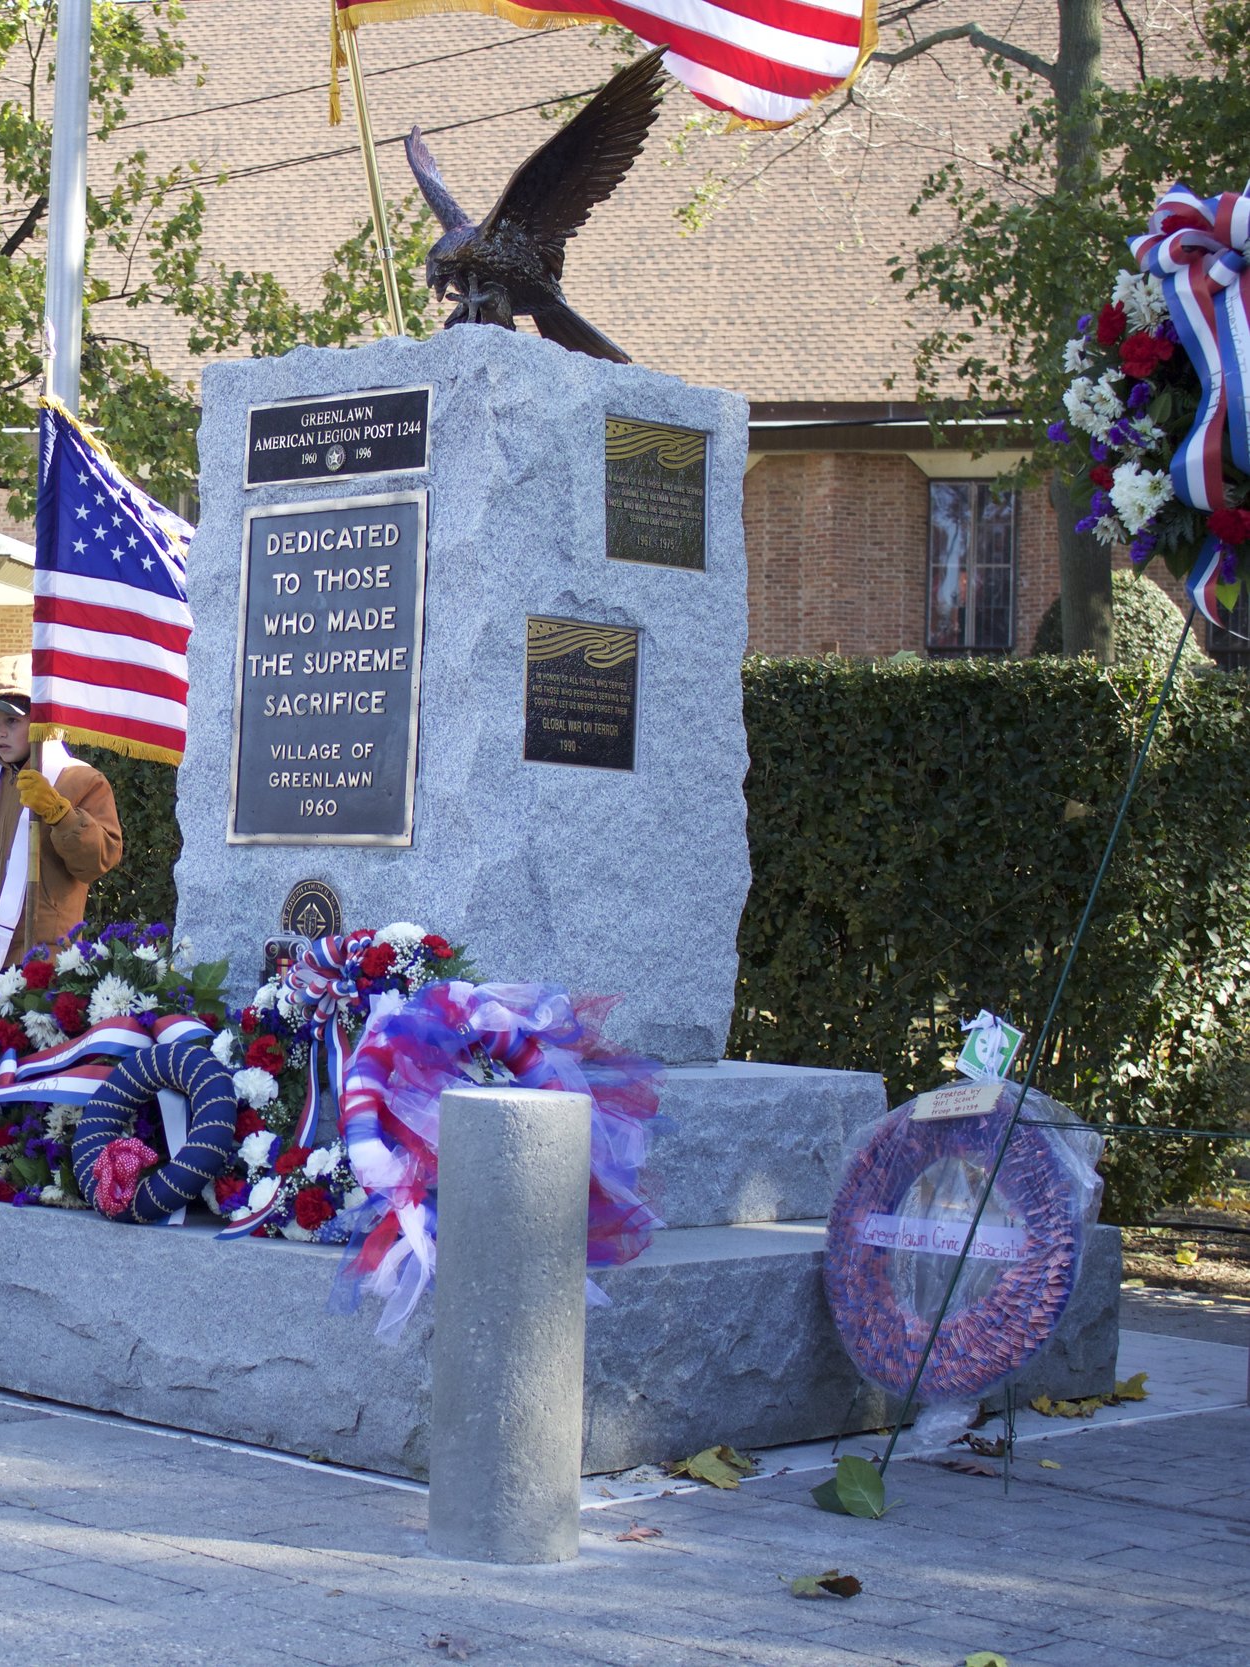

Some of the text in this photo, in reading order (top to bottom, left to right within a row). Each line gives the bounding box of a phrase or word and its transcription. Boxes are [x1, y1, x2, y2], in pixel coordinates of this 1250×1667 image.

[301, 406, 374, 427] GREENLAWN
[254, 420, 422, 452] AMERICAN LEGION POST 1244
[301, 452, 317, 465] 1960
[356, 447, 372, 459] 1996
[266, 522, 401, 557] DEDICATED
[273, 564, 392, 596] TO THOSE
[263, 606, 397, 638] WHO MADE
[248, 646, 408, 678] THE SUPREME
[569, 676, 578, 685] ALL
[579, 677, 595, 687] THOSE
[608, 681, 627, 691] SERVED
[263, 690, 387, 718] SACRIFICE
[543, 685, 560, 695] THOSE
[560, 688, 573, 697] WHO
[573, 689, 597, 700] PERISHED
[598, 692, 619, 702] SERVING
[619, 694, 631, 703] OUR
[558, 700, 568, 709] LET
[577, 702, 594, 712] NEVER
[594, 704, 613, 714] FORGET
[542, 717, 619, 736] GLOBAL WAR ON TERROR
[270, 742, 374, 760] VILLAGE OF
[560, 740, 576, 752] 1990
[268, 771, 374, 789] GREENLAWN
[299, 799, 338, 818] 1960
[286, 887, 304, 912] JOSEPH
[303, 883, 330, 898] COUNCIL
[863, 1217, 929, 1248] Greenlawn
[932, 1226, 961, 1252] Civic
